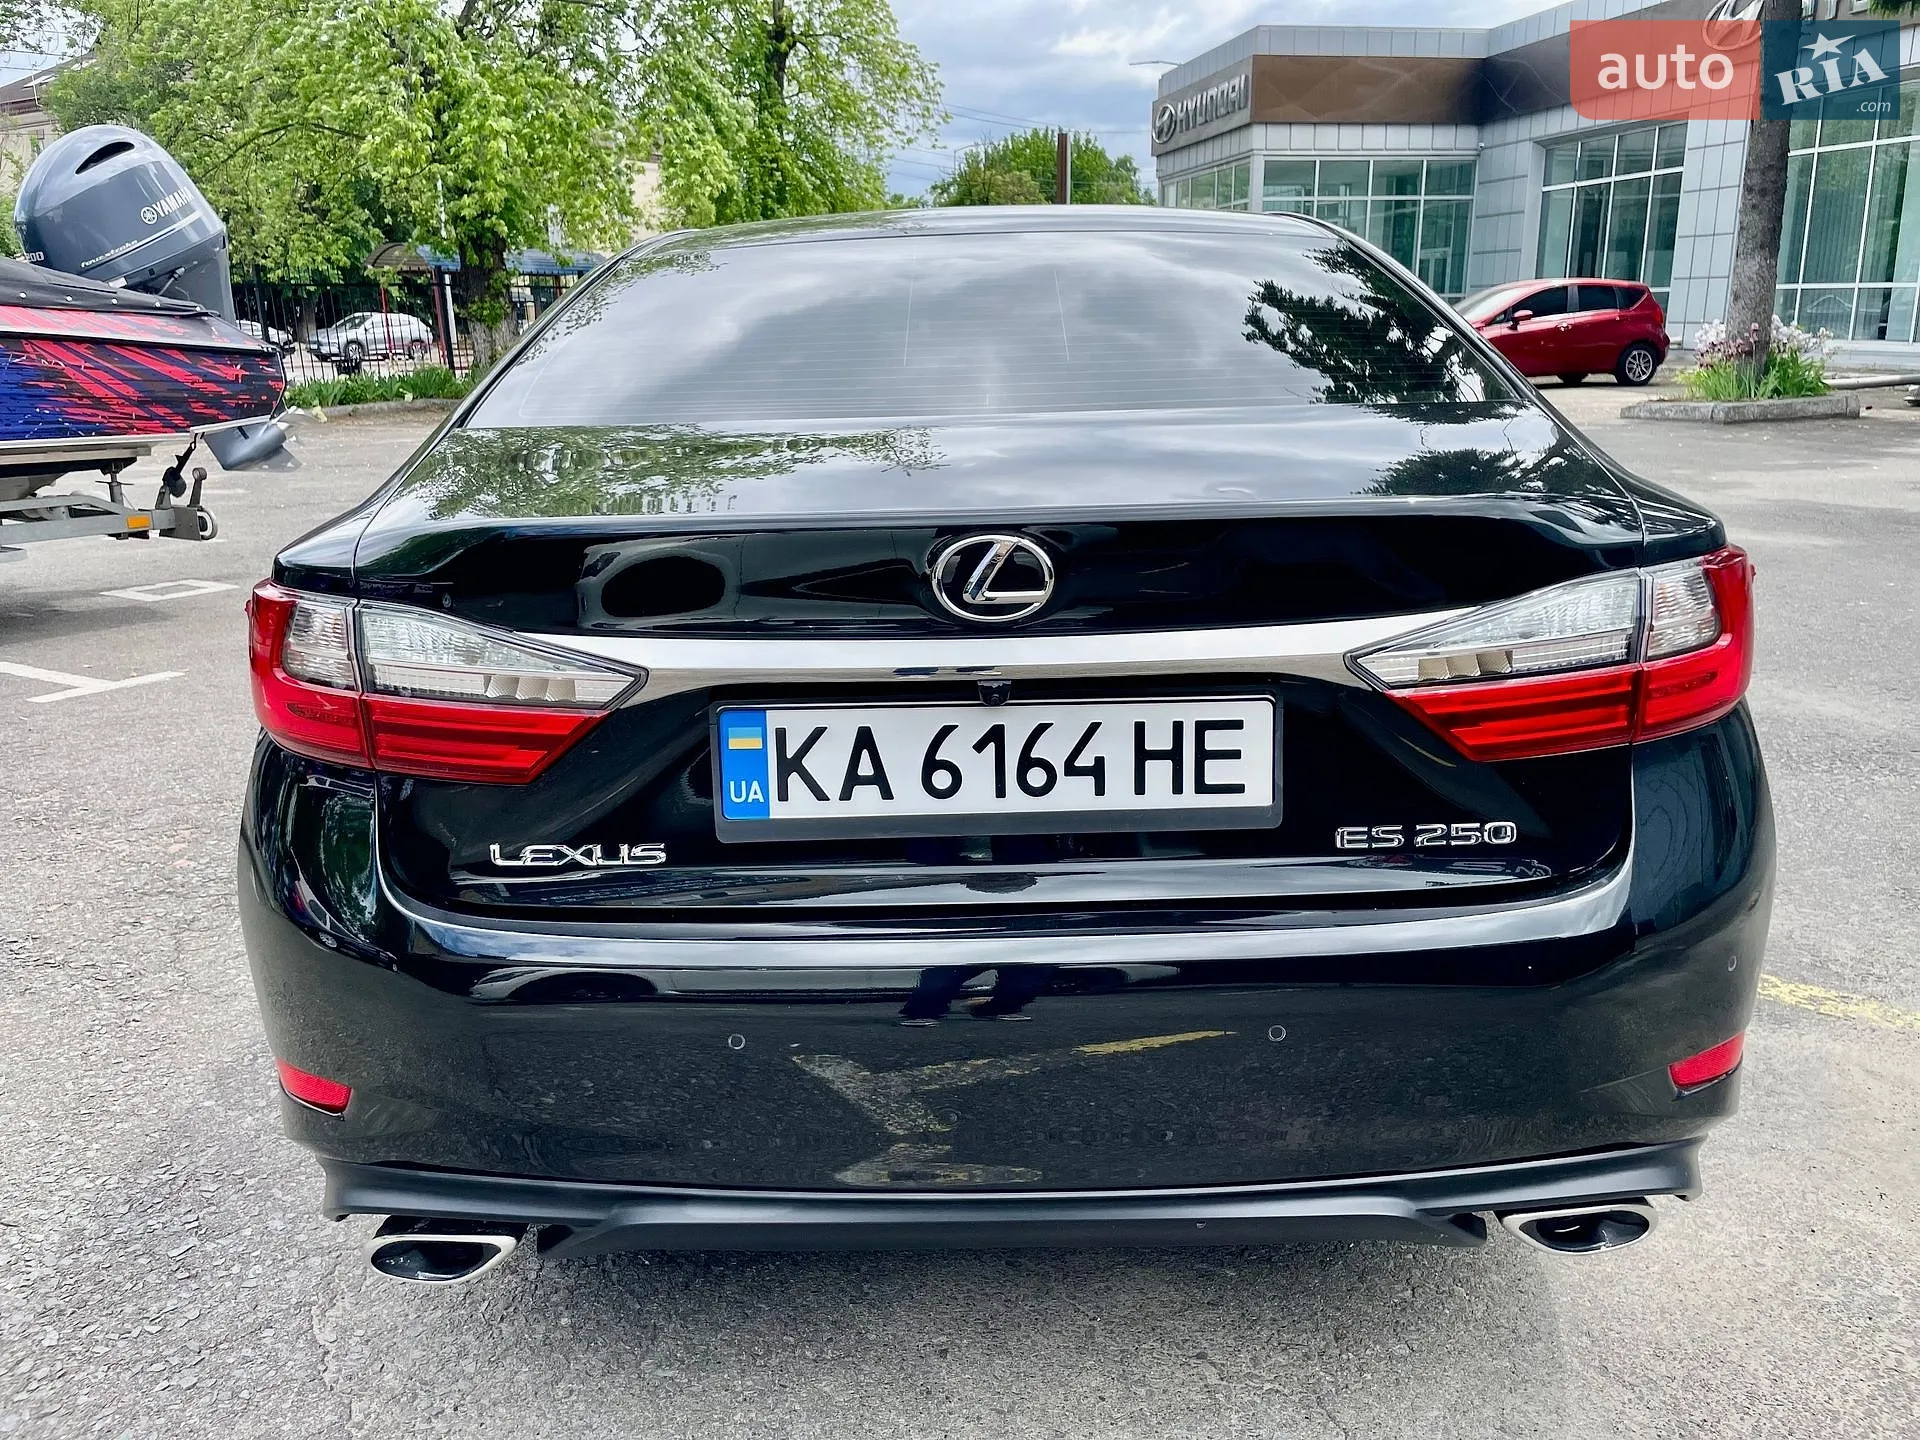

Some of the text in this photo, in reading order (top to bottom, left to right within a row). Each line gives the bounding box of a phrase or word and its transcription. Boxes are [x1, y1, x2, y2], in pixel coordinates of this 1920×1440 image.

[1177, 73, 1247, 133] HYUNDAI
[151, 187, 194, 218] YAMAHA
[775, 719, 1246, 802] KA 6164 HE
[729, 780, 764, 803] UA
[1335, 821, 1517, 849] ES 250
[489, 843, 667, 866] LEXUS
